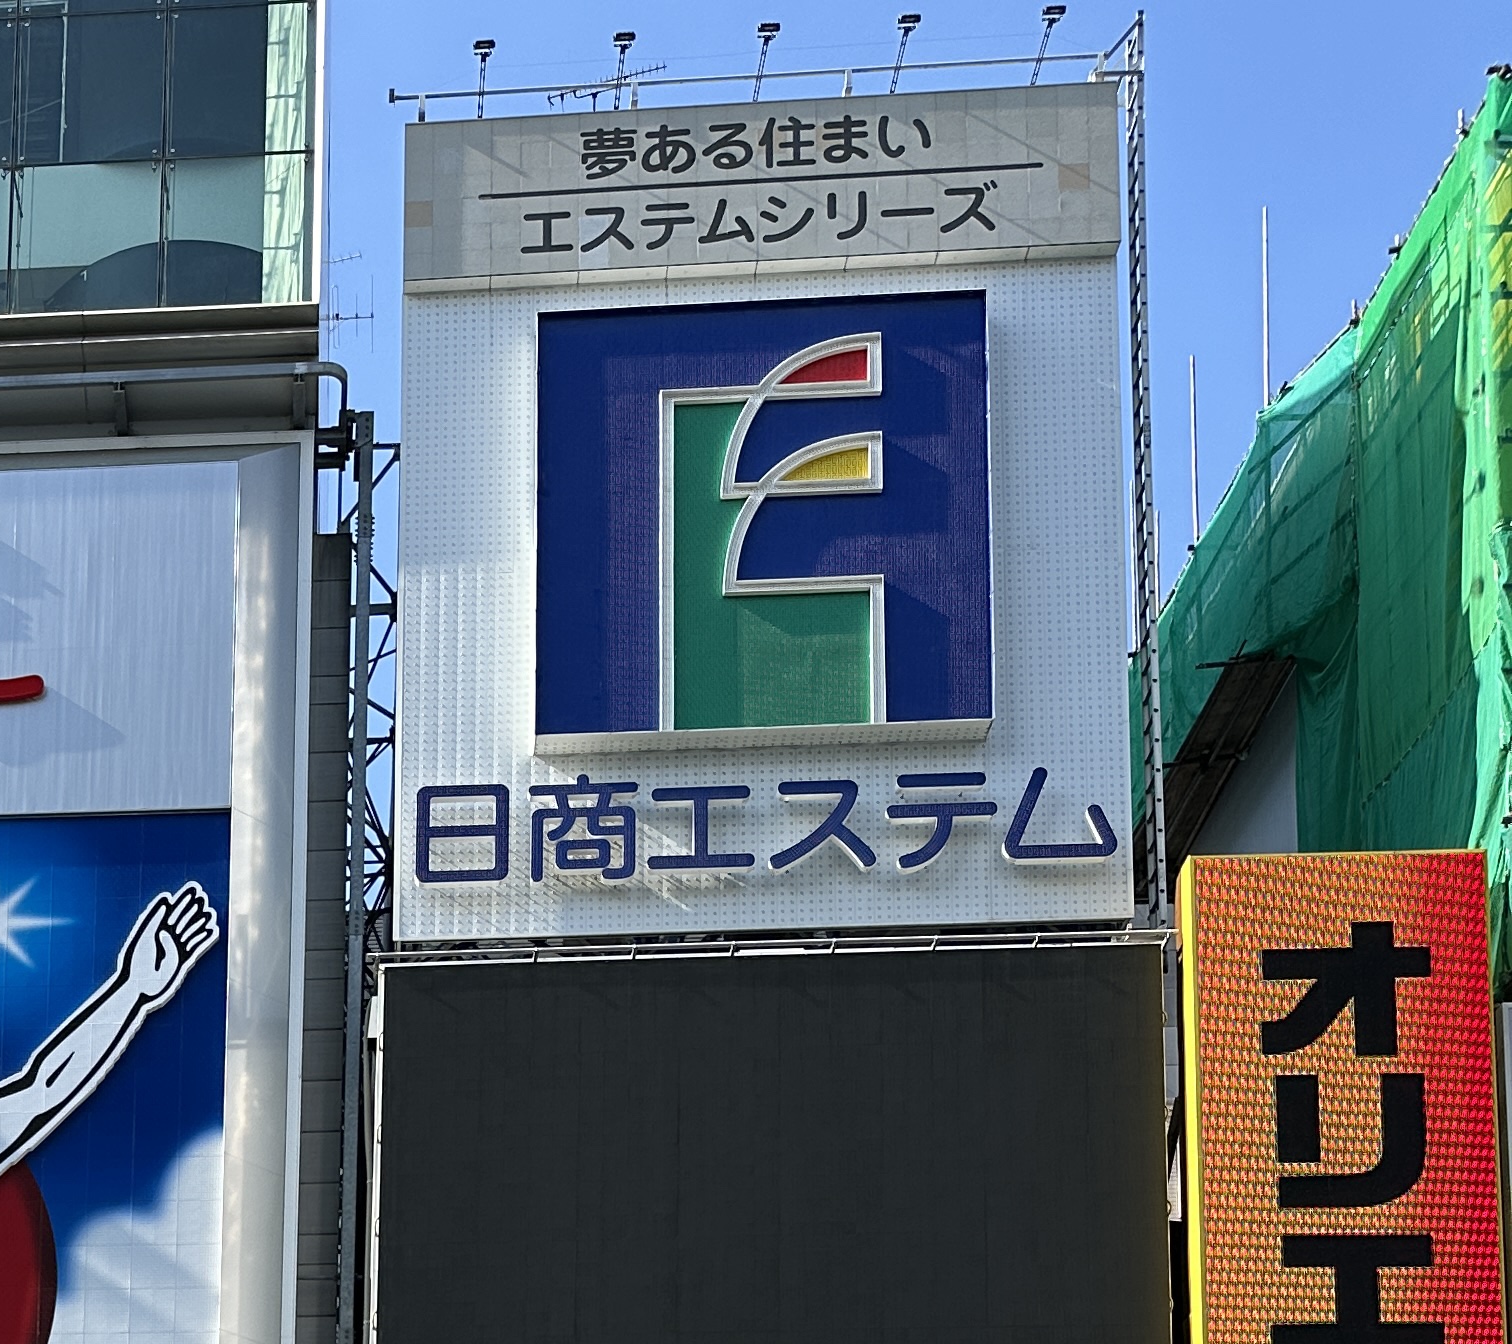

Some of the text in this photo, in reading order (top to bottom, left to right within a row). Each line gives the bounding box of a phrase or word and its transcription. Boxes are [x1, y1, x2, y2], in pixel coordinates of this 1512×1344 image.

[579, 114, 932, 180] 夢ある住まい
[520, 179, 1000, 254] エステムシリーズ
[415, 765, 1119, 886] 日商エステム
